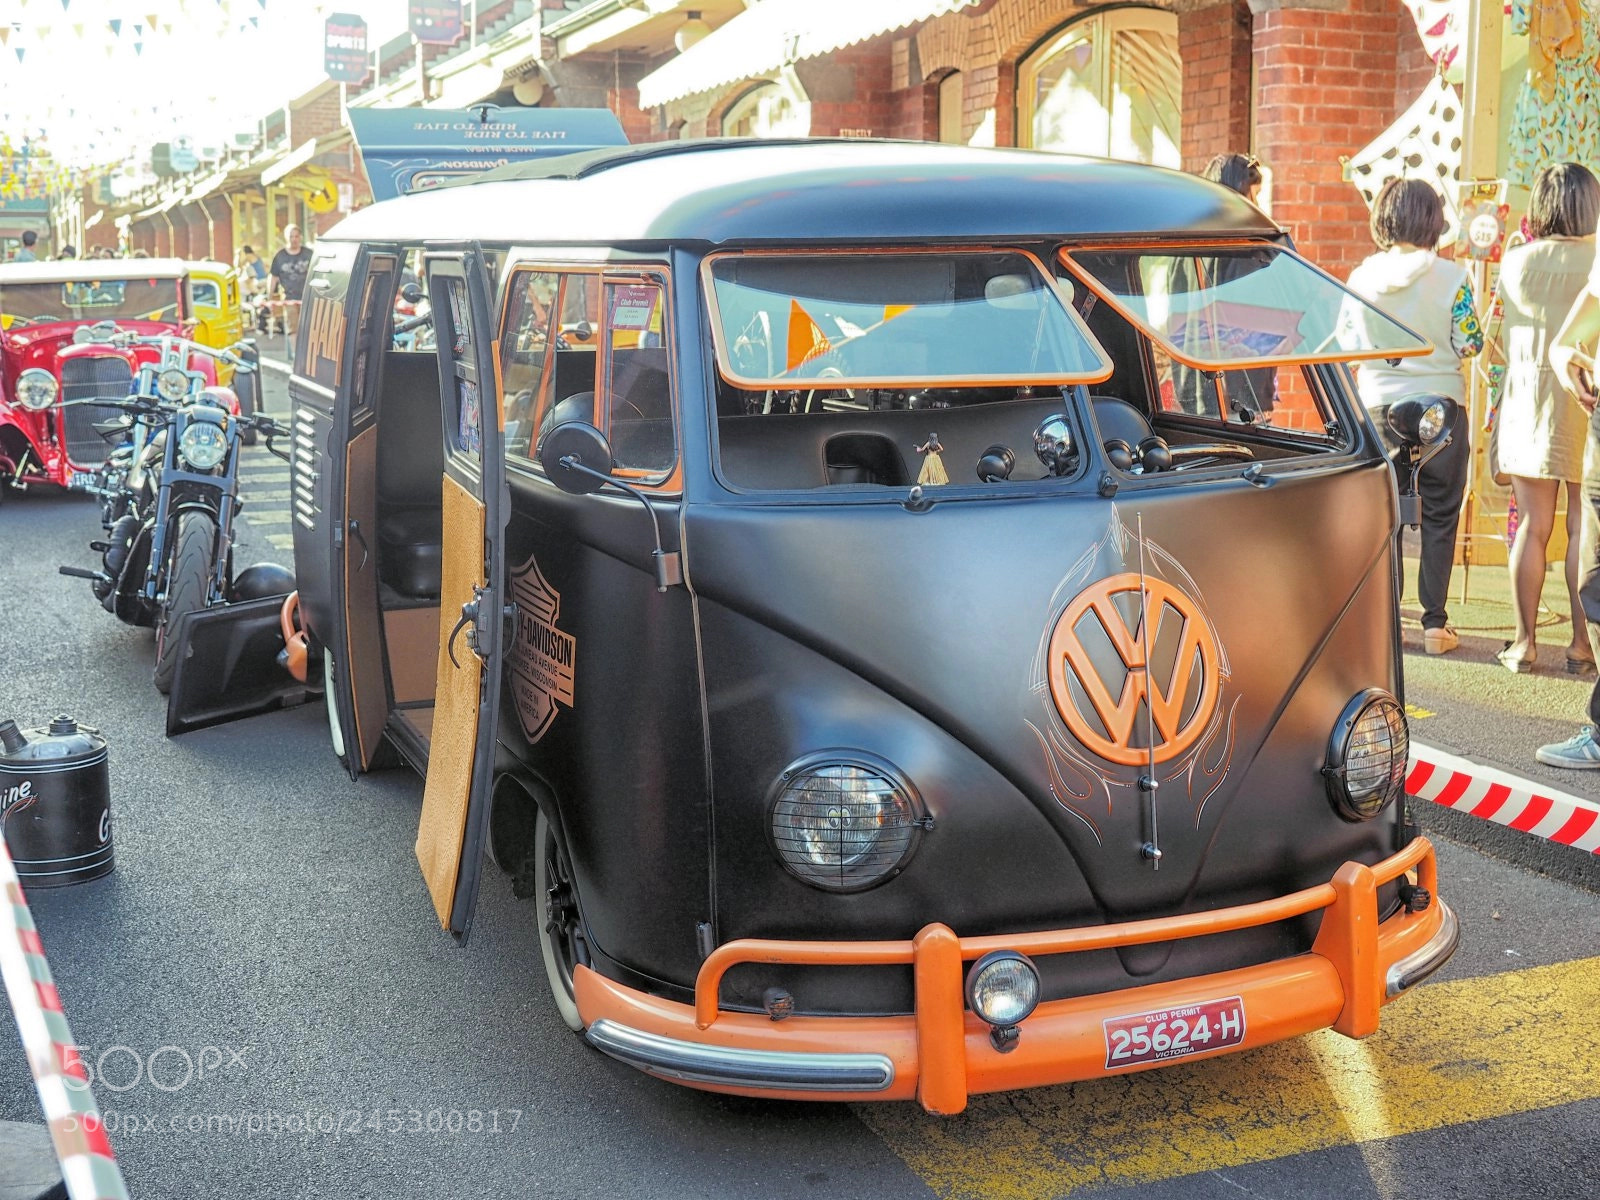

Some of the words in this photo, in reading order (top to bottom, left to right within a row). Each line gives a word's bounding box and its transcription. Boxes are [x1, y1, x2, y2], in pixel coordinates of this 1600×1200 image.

[414, 123, 449, 131] LIVE
[453, 123, 475, 131] TO
[481, 123, 516, 131] RIDE
[465, 131, 501, 139] RIDE
[505, 131, 527, 139] TO
[1145, 1012, 1168, 1024] CLUB
[1170, 1006, 1201, 1018] PERMIT
[1155, 1045, 1195, 1059] VICTORIA
